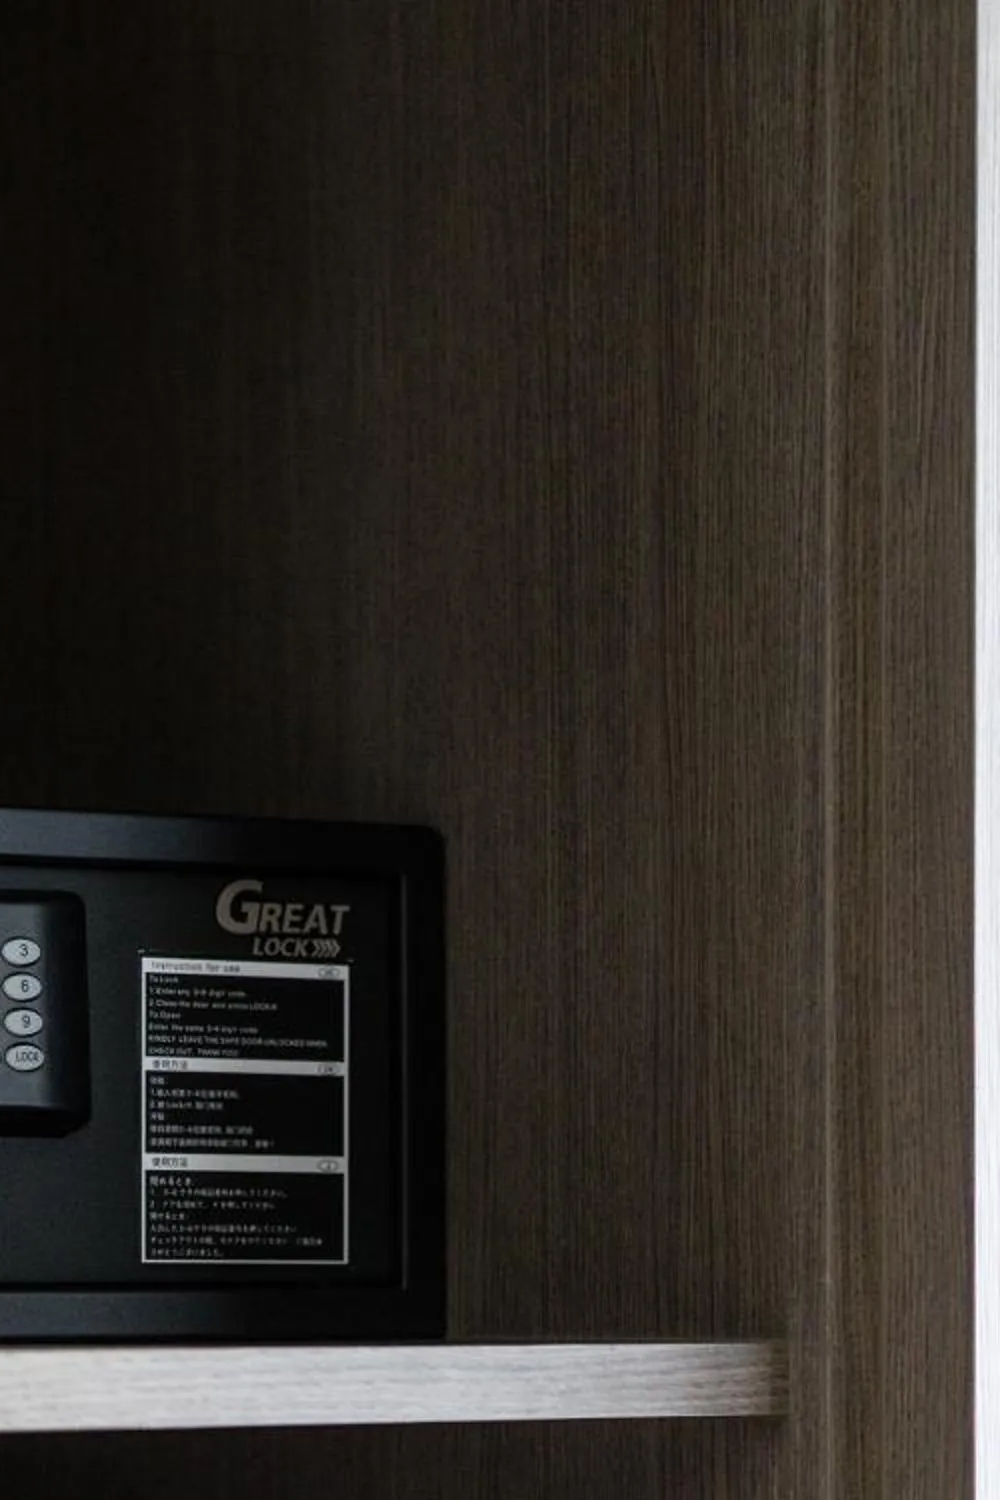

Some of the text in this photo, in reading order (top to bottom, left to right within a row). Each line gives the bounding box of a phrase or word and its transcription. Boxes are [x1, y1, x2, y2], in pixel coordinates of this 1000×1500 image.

[215, 879, 350, 935] GREAT
[19, 943, 28, 957] 3
[253, 937, 308, 957] LOCK
[21, 979, 29, 993] 6
[22, 1015, 31, 1028] 9
[15, 1051, 39, 1063] LOCK
